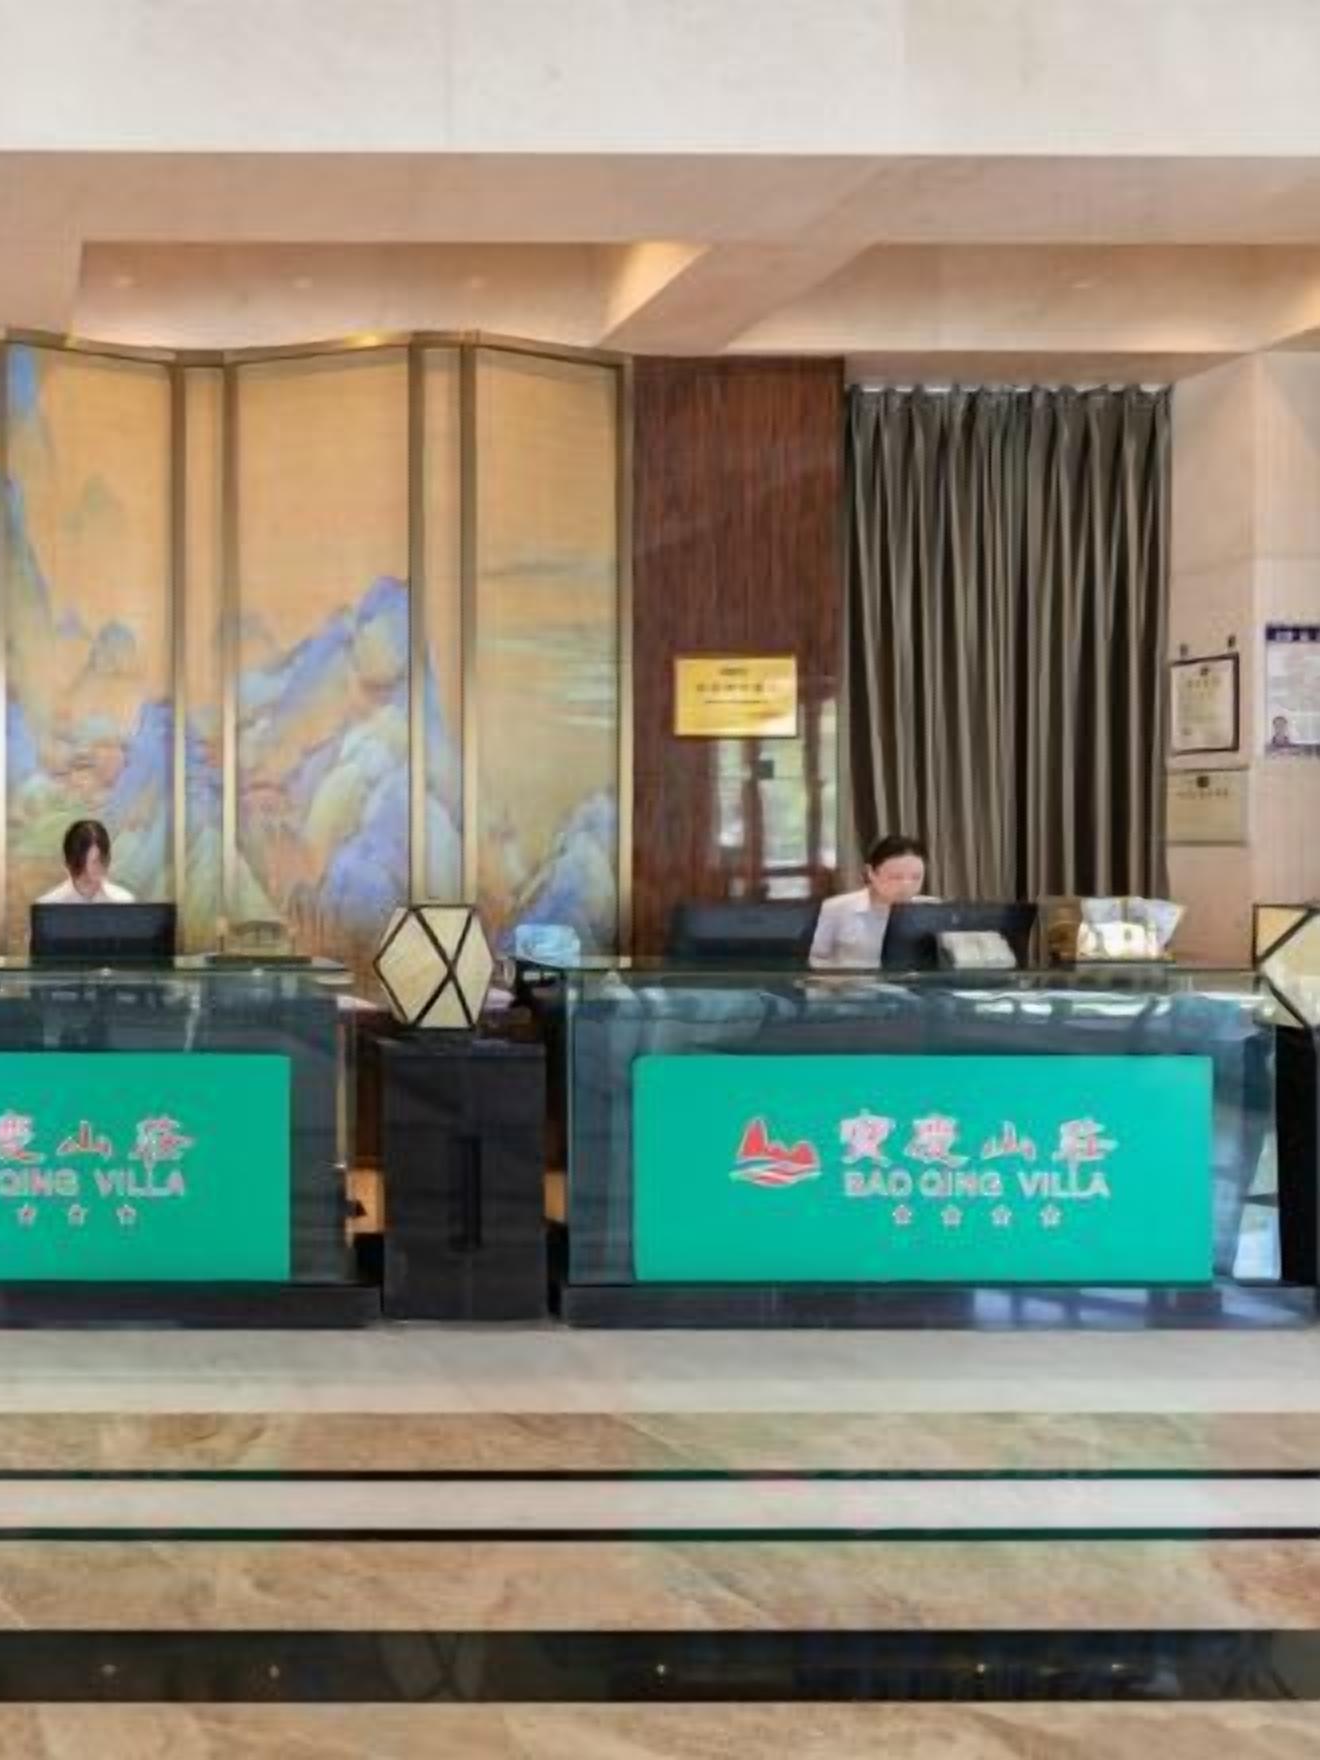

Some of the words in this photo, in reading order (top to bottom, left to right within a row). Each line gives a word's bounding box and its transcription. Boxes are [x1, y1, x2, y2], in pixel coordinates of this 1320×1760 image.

[95, 1168, 186, 1197] VILLA
[843, 1170, 913, 1198] BAO
[918, 1170, 1004, 1198] QING
[1017, 1170, 1111, 1198] VILLA
